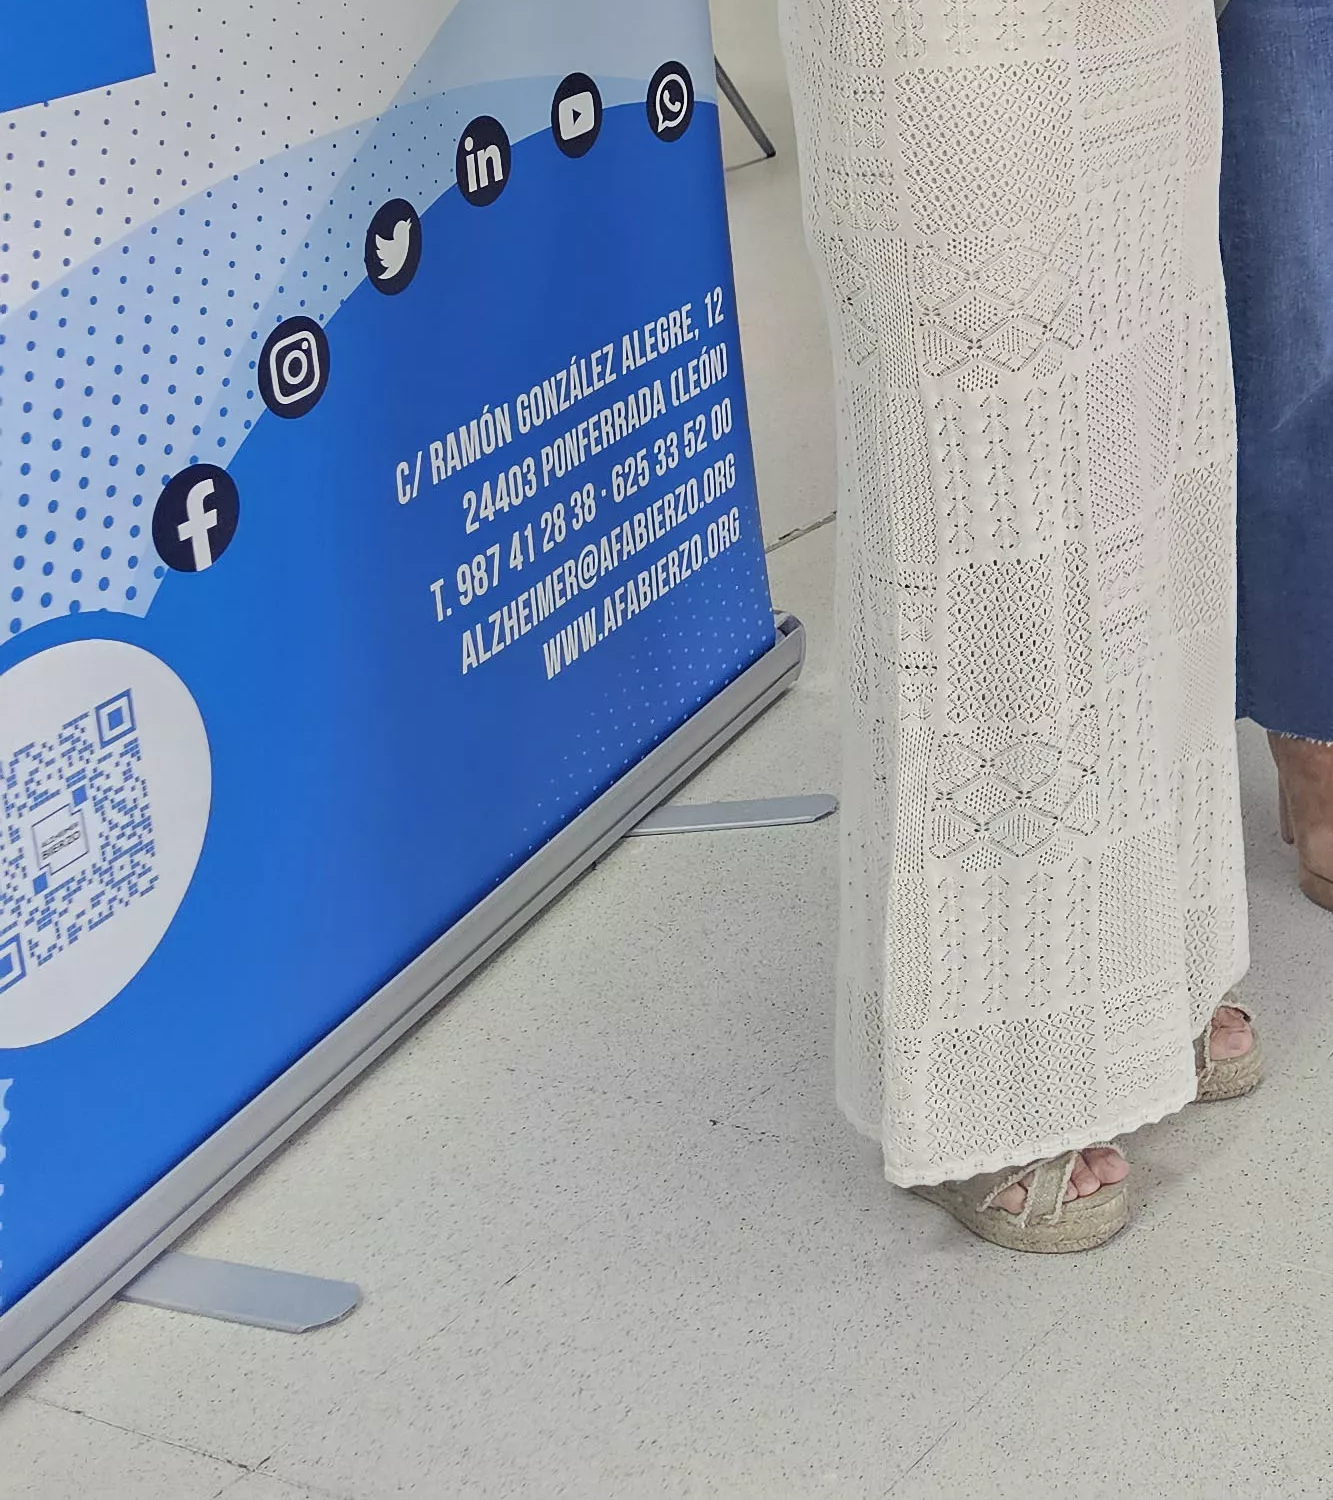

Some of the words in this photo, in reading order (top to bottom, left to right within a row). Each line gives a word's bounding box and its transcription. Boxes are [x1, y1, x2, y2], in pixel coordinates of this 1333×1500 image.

[396, 450, 424, 505] C/
[429, 401, 513, 486] RAMÓN
[516, 344, 617, 435] GONZÁLEZ
[621, 303, 700, 375] ALEGRE,
[704, 286, 725, 327] 12
[463, 457, 538, 534] 24403
[543, 380, 667, 487] PONFERRADA
[670, 342, 728, 406] (LEÓN)
[430, 578, 452, 622] T.
[457, 546, 502, 606] 987
[509, 521, 536, 572] 41
[540, 506, 567, 552] 28
[571, 484, 597, 530] 38
[611, 448, 650, 503] 625
[654, 432, 680, 477] 33
[683, 414, 706, 459] 52
[710, 398, 733, 441] 00
[461, 453, 736, 675] ALZHEIMER@AFABIERZO.ORG
[542, 506, 741, 680] WWW.AFABIERZO.ORG
